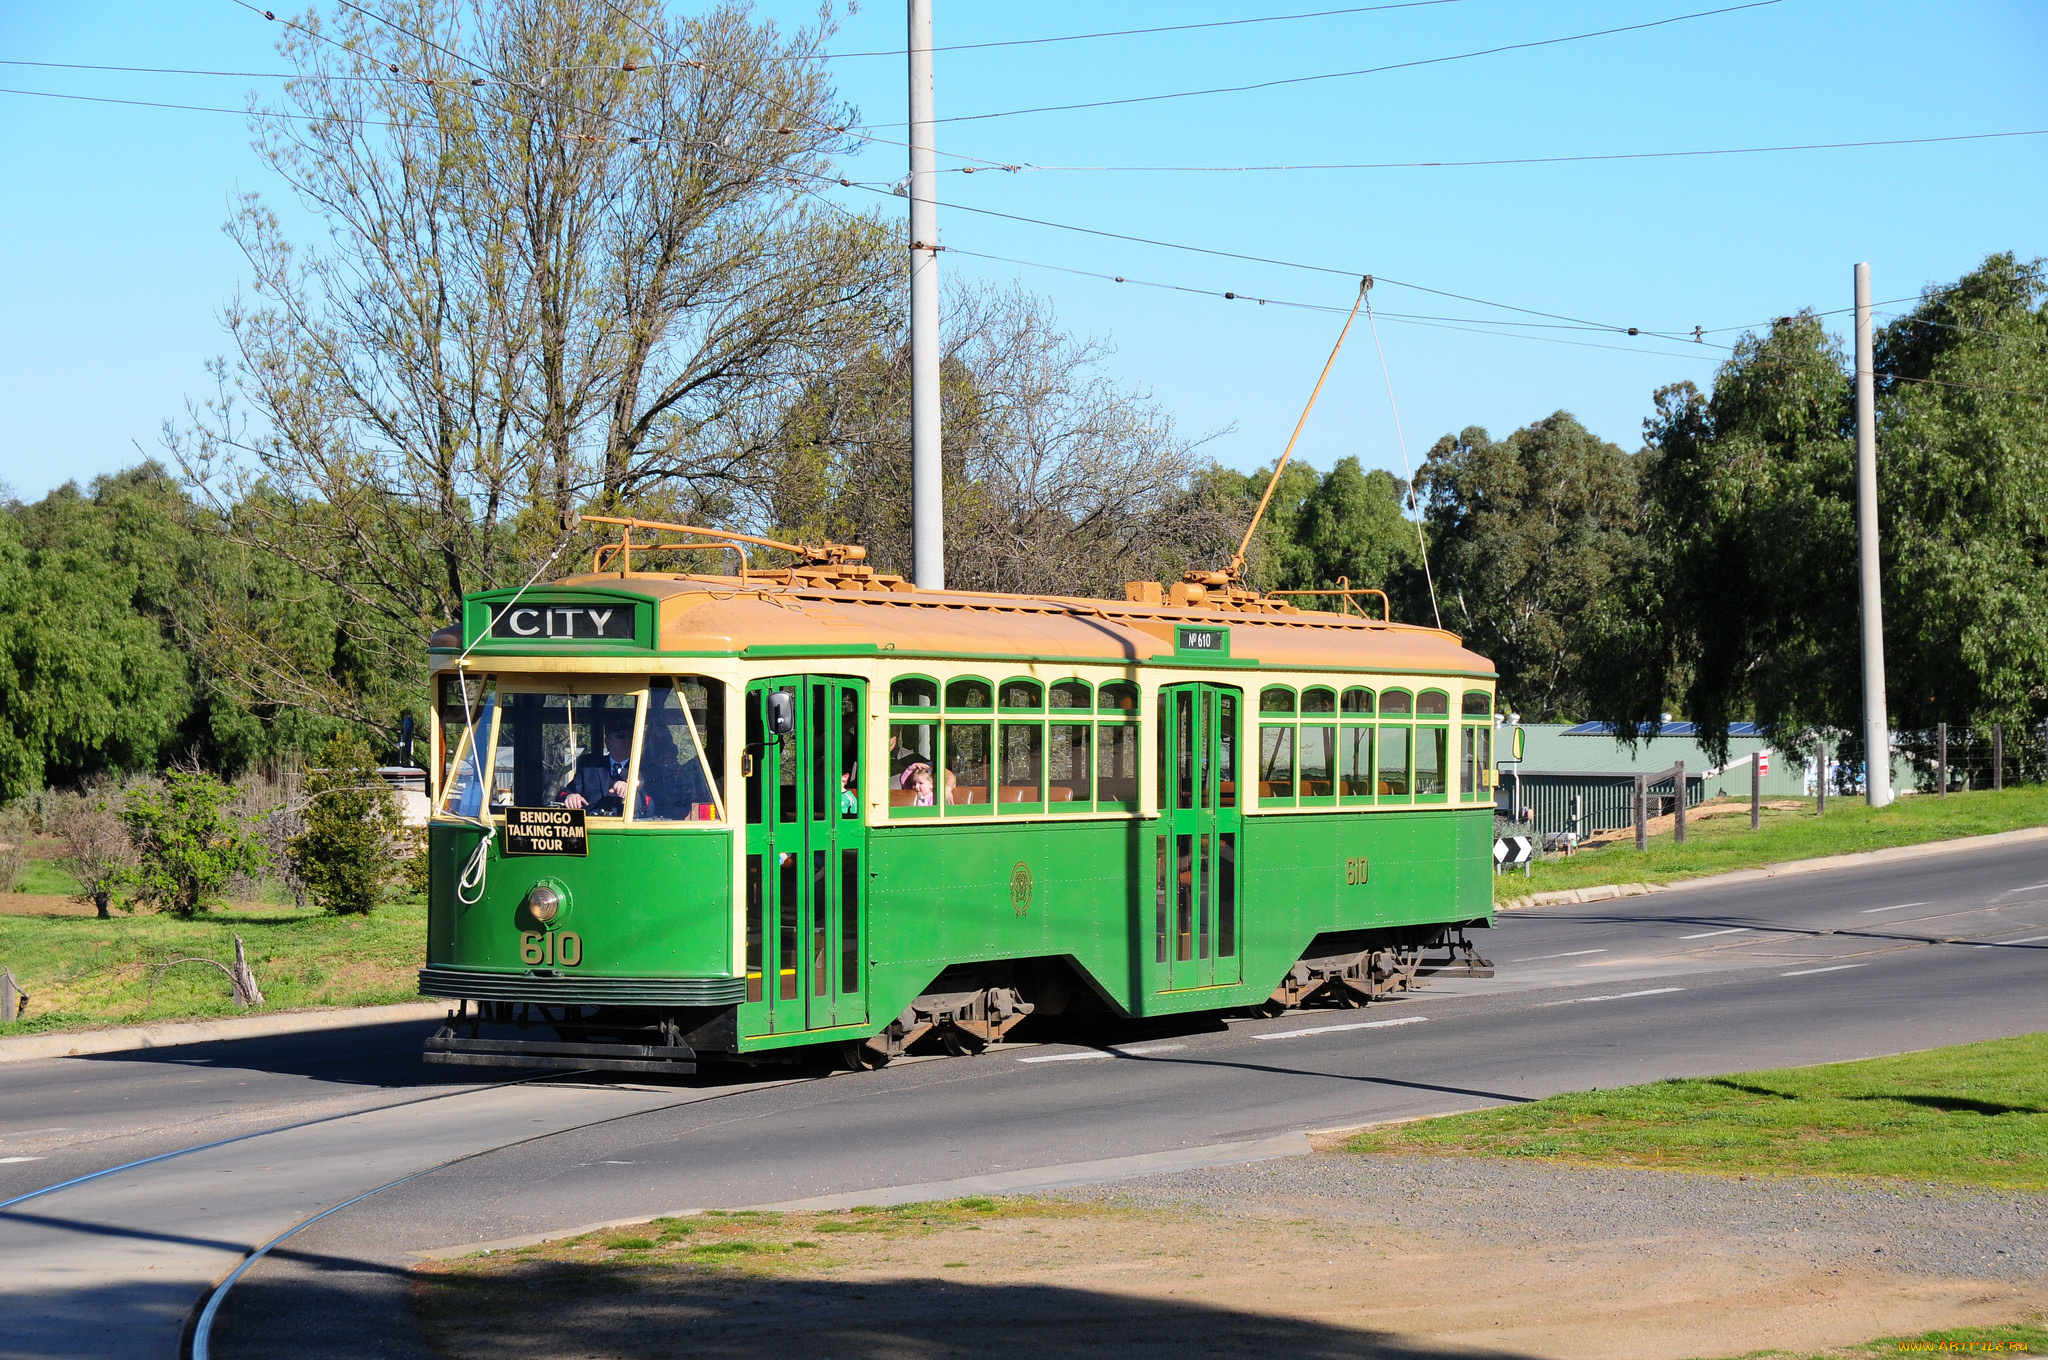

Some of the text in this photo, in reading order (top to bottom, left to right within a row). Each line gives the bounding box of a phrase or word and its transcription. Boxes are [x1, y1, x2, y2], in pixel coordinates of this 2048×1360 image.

[509, 608, 614, 636] CITY
[1197, 633, 1211, 648] 610
[520, 811, 571, 824] BENDIGO
[507, 824, 584, 838] TALKING TRAM
[530, 838, 563, 851] TOUR
[1346, 856, 1369, 885] 610
[520, 930, 583, 967] 610
